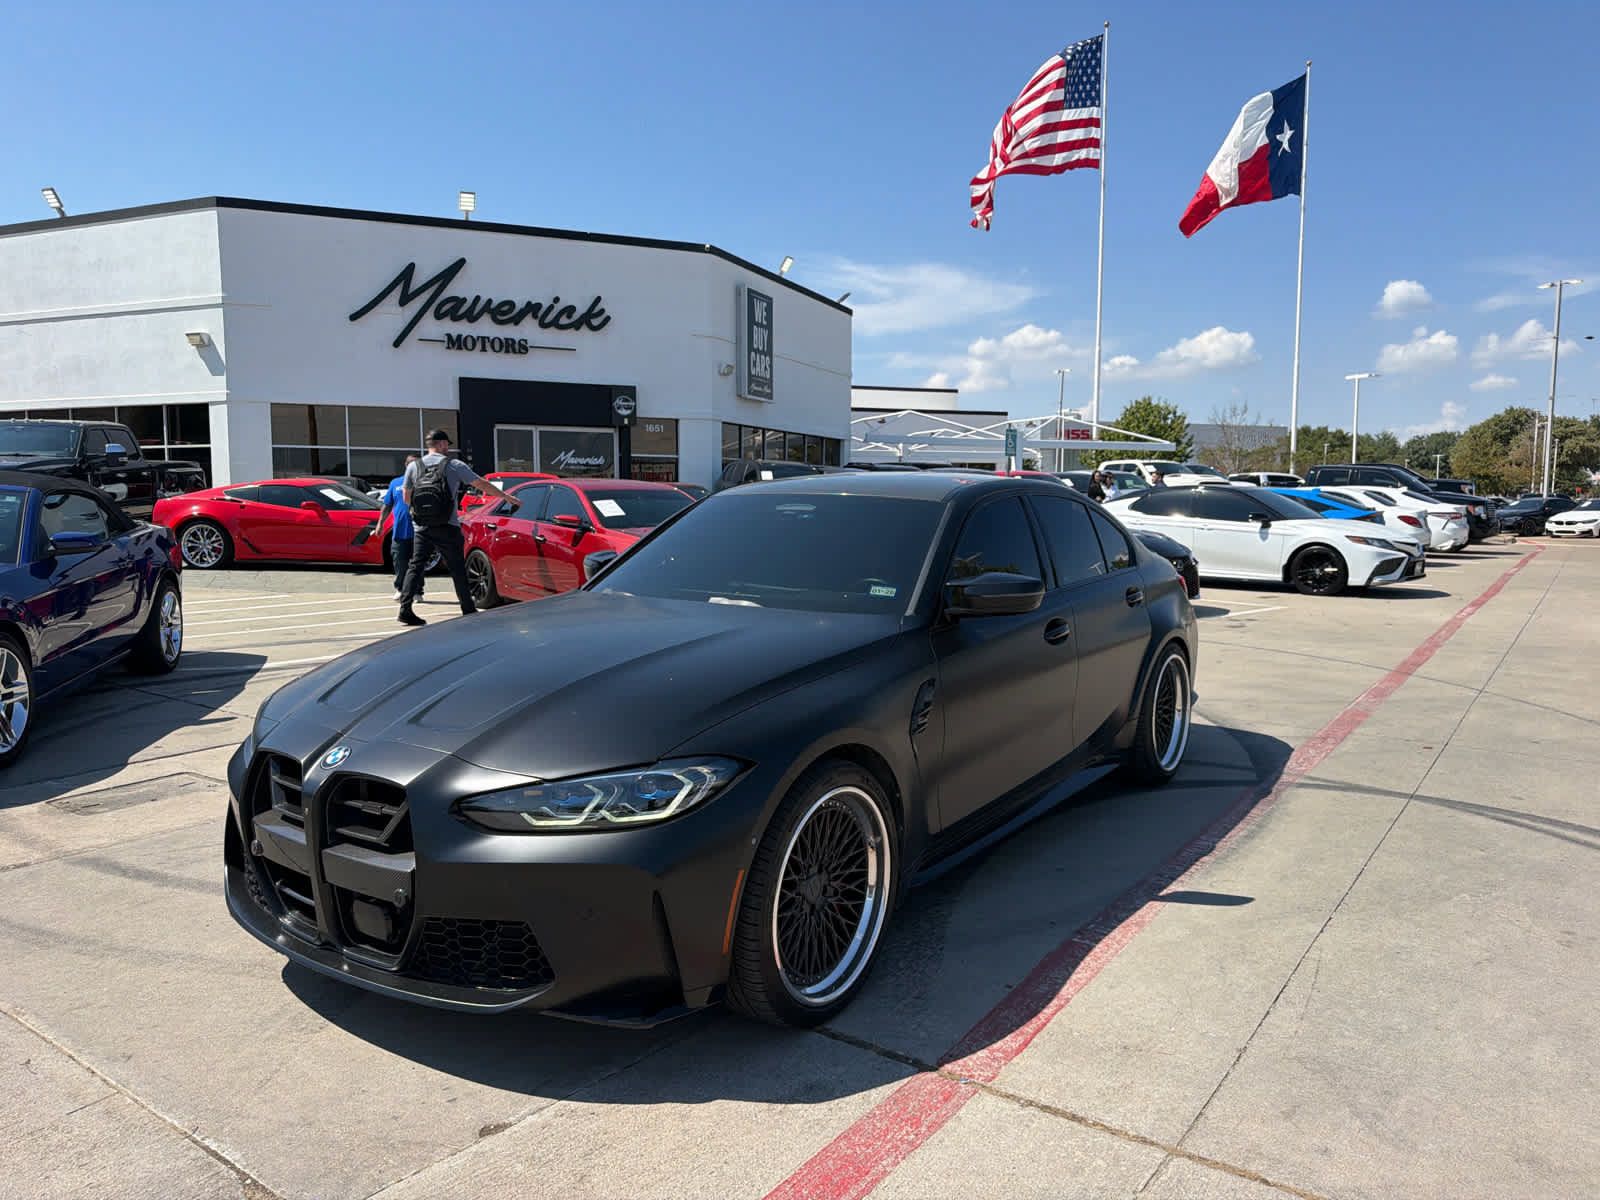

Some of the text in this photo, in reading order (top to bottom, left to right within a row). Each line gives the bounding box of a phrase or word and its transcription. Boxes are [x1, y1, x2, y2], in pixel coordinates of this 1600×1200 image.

[348, 257, 611, 348] Maverick
[753, 298, 767, 325] WE
[445, 333, 529, 355] MOTORS
[753, 325, 769, 352] BUY
[750, 351, 771, 379] CARS
[646, 423, 664, 433] 1651
